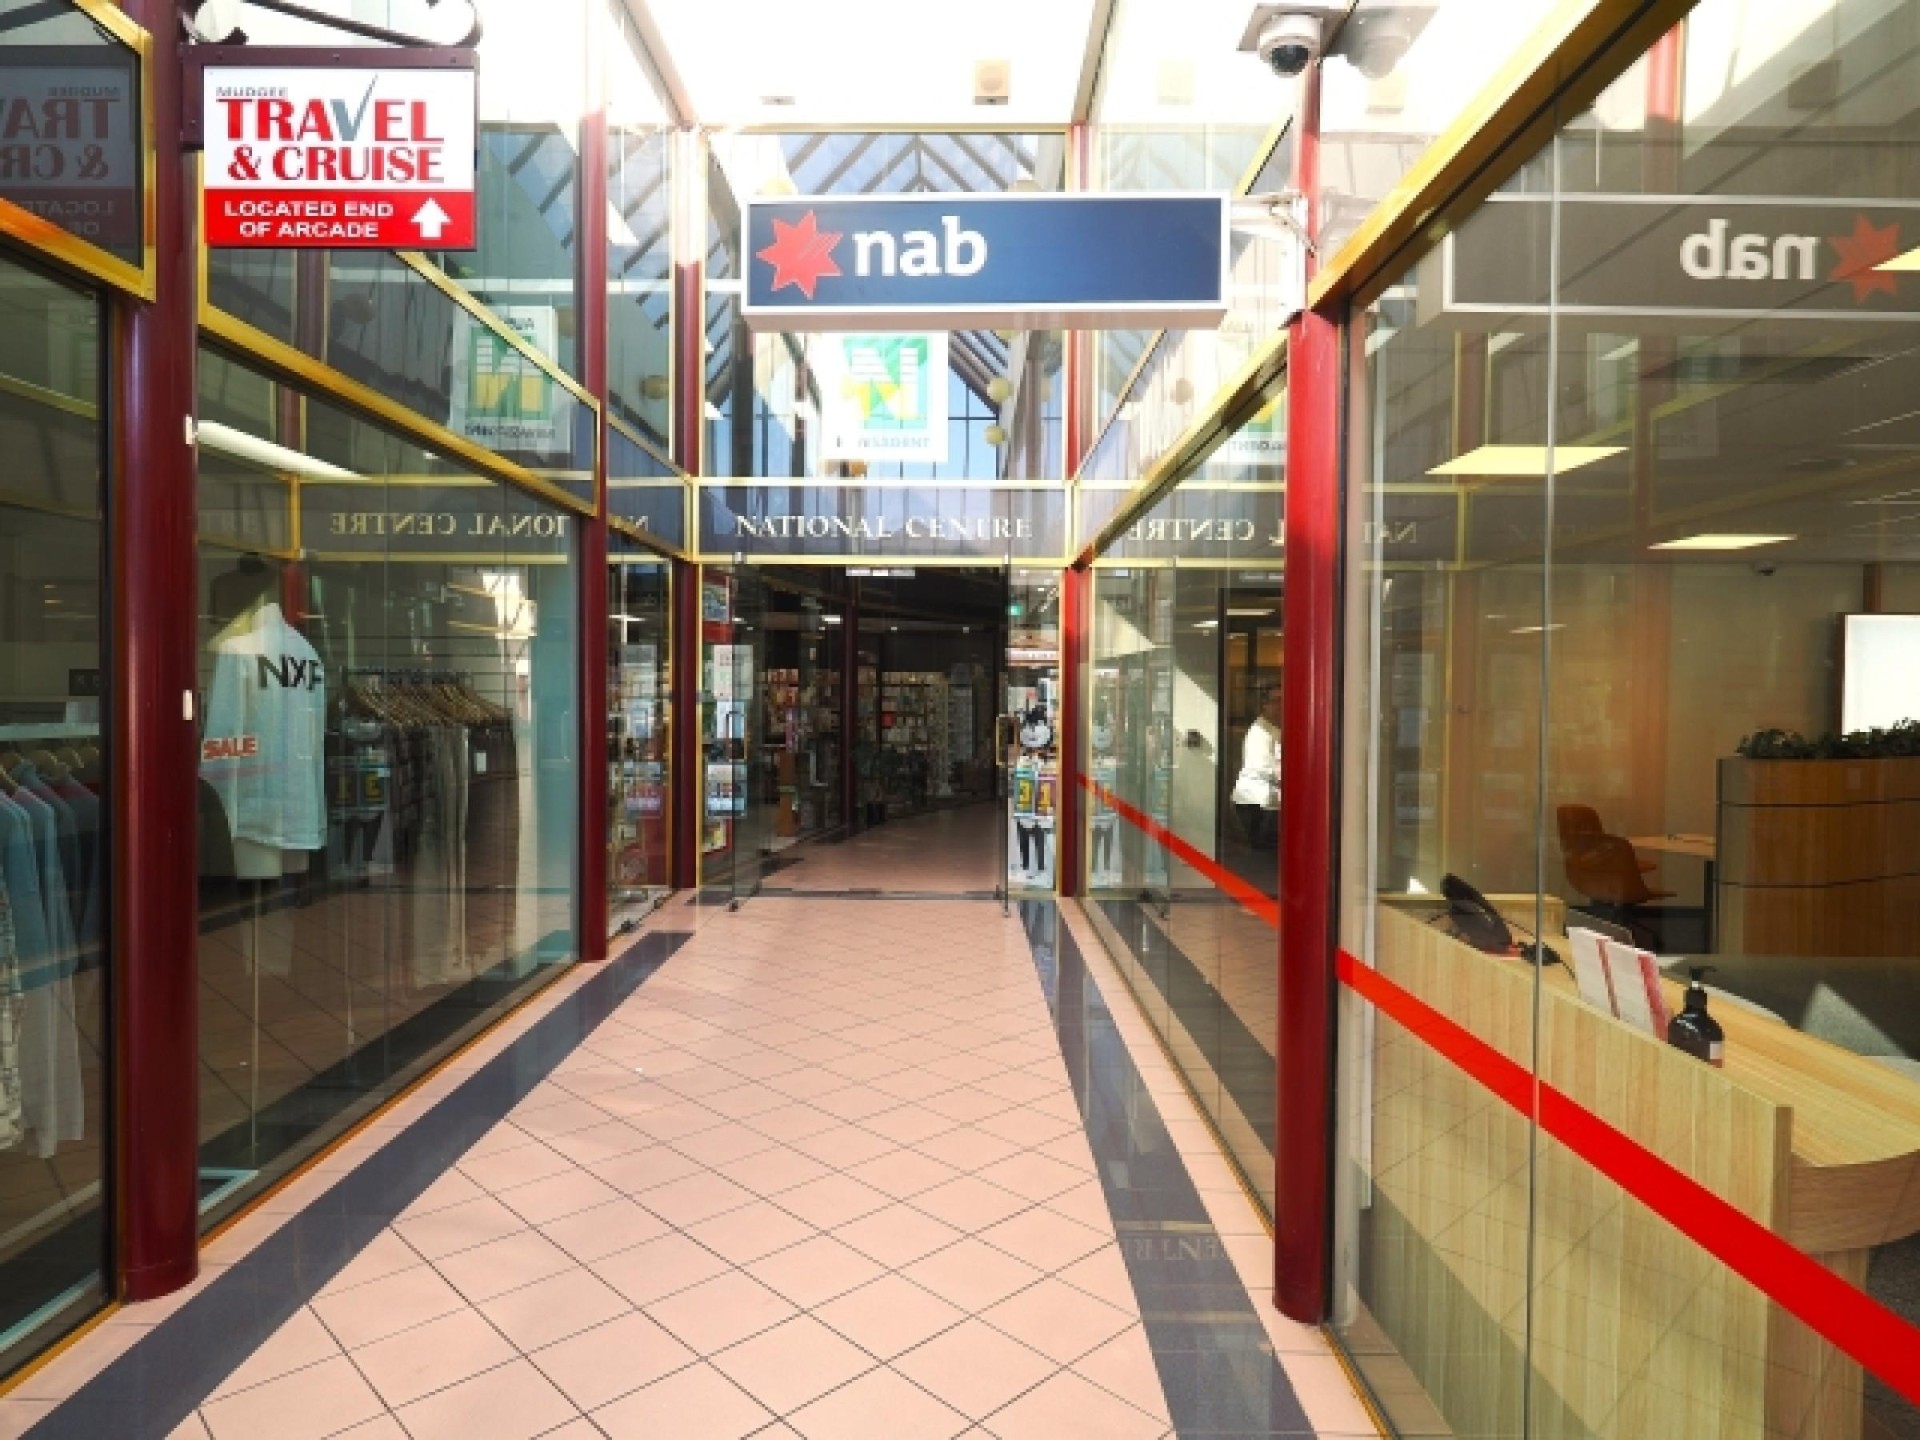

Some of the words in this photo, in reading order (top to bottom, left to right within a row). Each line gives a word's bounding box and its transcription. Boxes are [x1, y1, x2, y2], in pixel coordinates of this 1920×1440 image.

[216, 87, 288, 96] MUDGEE
[216, 74, 444, 142] TRAVEL
[228, 145, 262, 181] &
[272, 146, 444, 183] CRUISE
[224, 200, 337, 217] LOCATED
[345, 201, 394, 217] END
[239, 221, 272, 238] OF
[278, 221, 379, 238] ARCADE
[852, 215, 987, 276] nab
[734, 515, 892, 538] NATIONAL
[905, 515, 1033, 540] CENTRE
